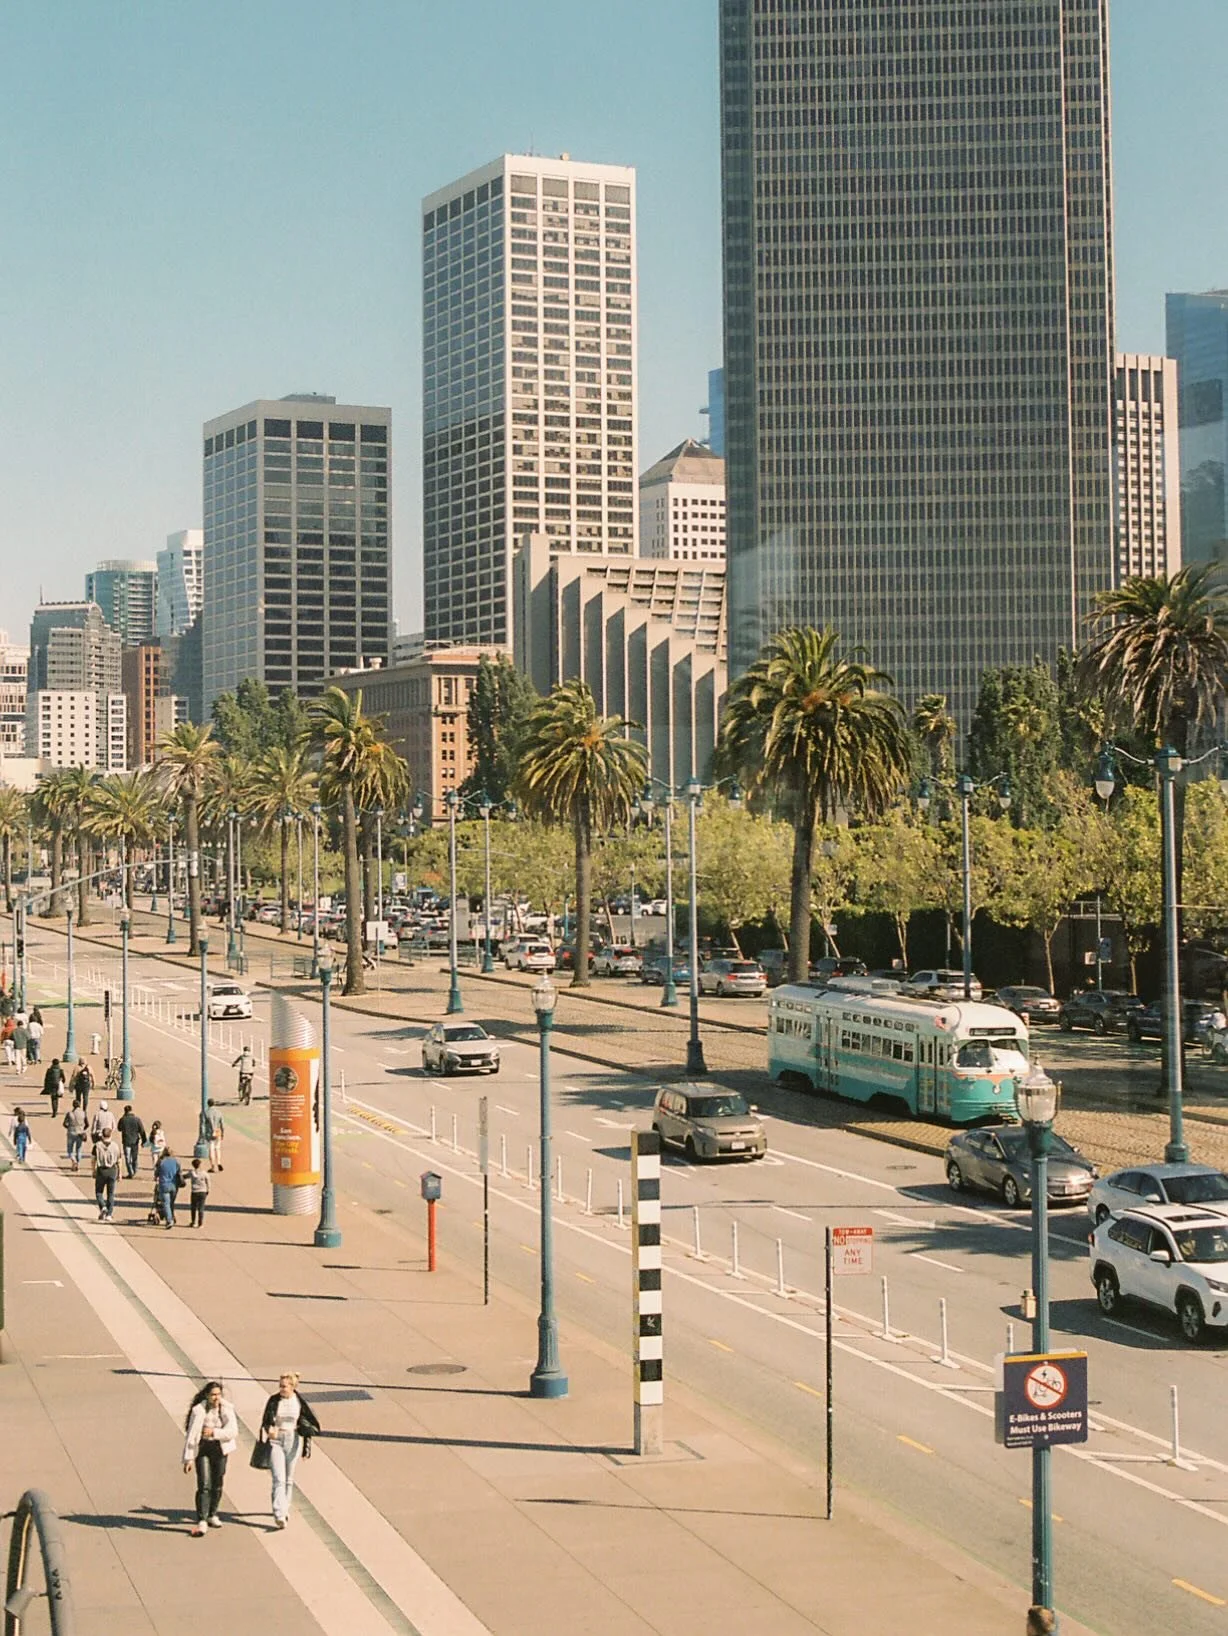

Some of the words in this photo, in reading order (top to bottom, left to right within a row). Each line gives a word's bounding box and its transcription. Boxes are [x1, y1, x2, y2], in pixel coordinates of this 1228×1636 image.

[834, 1236, 845, 1245] NO
[1009, 1414, 1038, 1422] E-Bikes
[1048, 1411, 1082, 1420] Scooters
[1010, 1425, 1031, 1434] Must
[1031, 1424, 1047, 1433] Use
[1048, 1422, 1082, 1432] Bikeway
